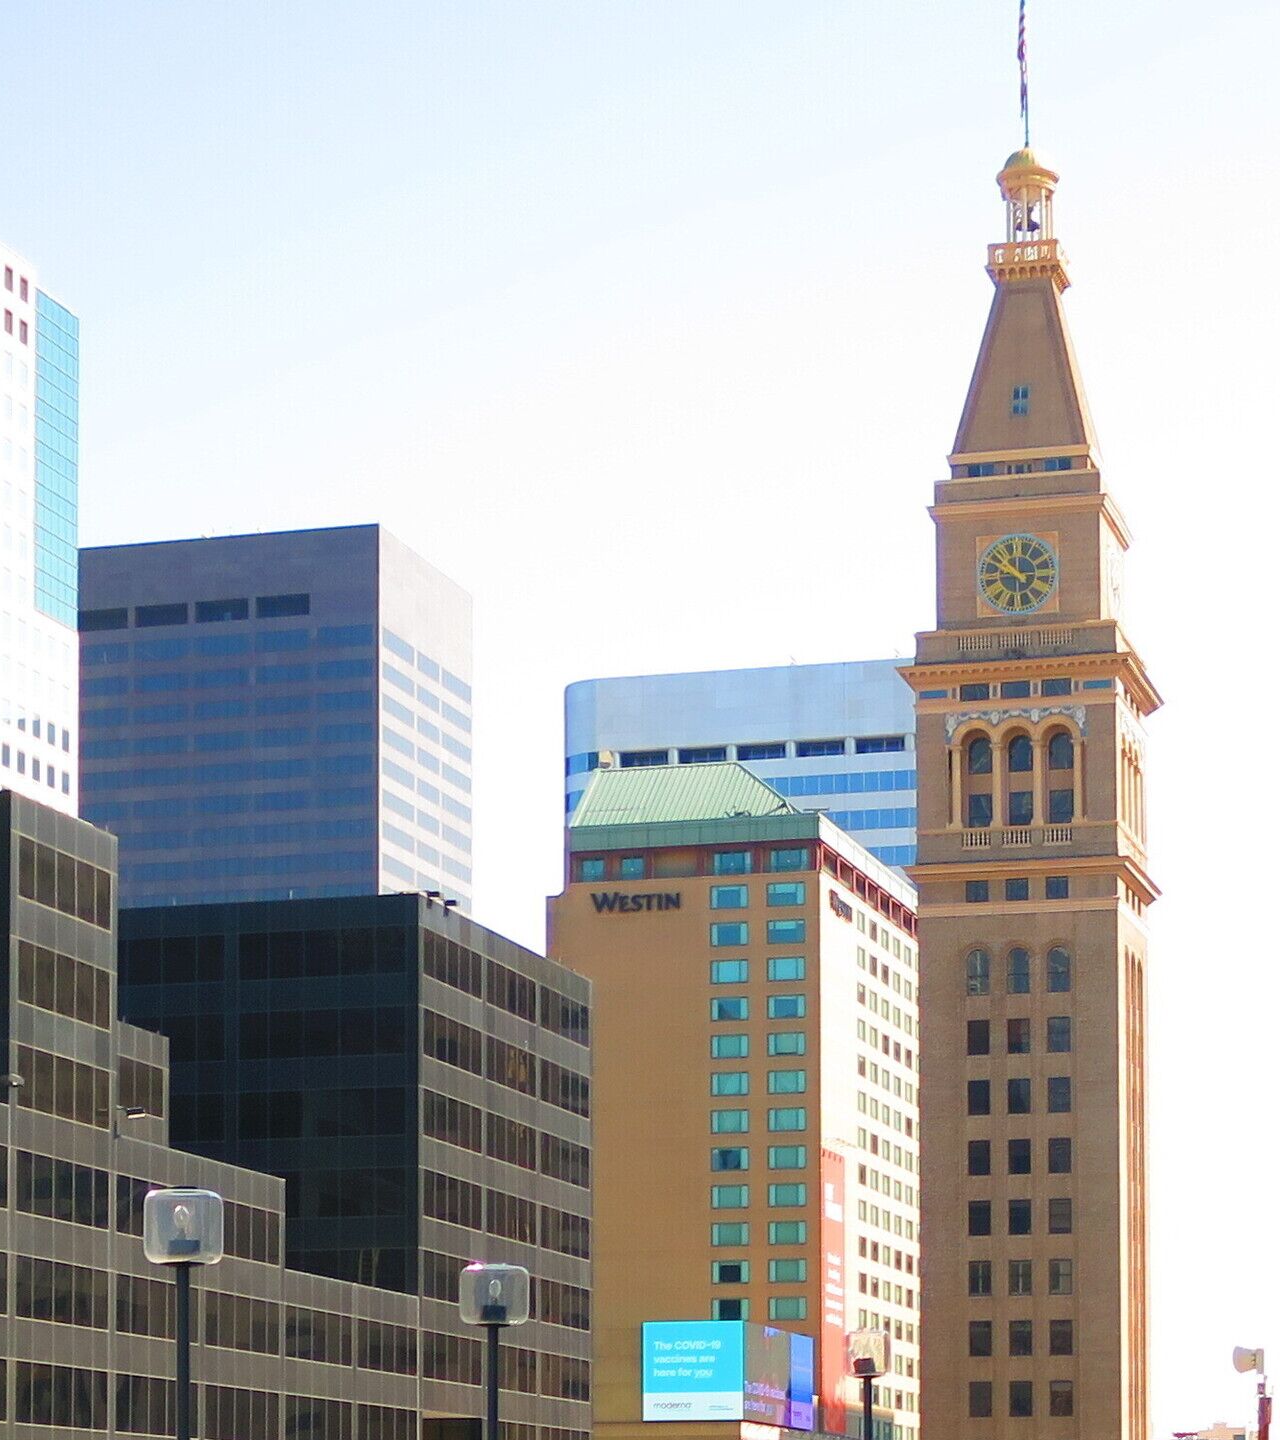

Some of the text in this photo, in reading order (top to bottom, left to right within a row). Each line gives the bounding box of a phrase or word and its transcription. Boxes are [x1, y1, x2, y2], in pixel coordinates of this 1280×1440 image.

[590, 892, 681, 913] WESTIN
[654, 1341, 673, 1350] The
[654, 1367, 713, 1378] here for you
